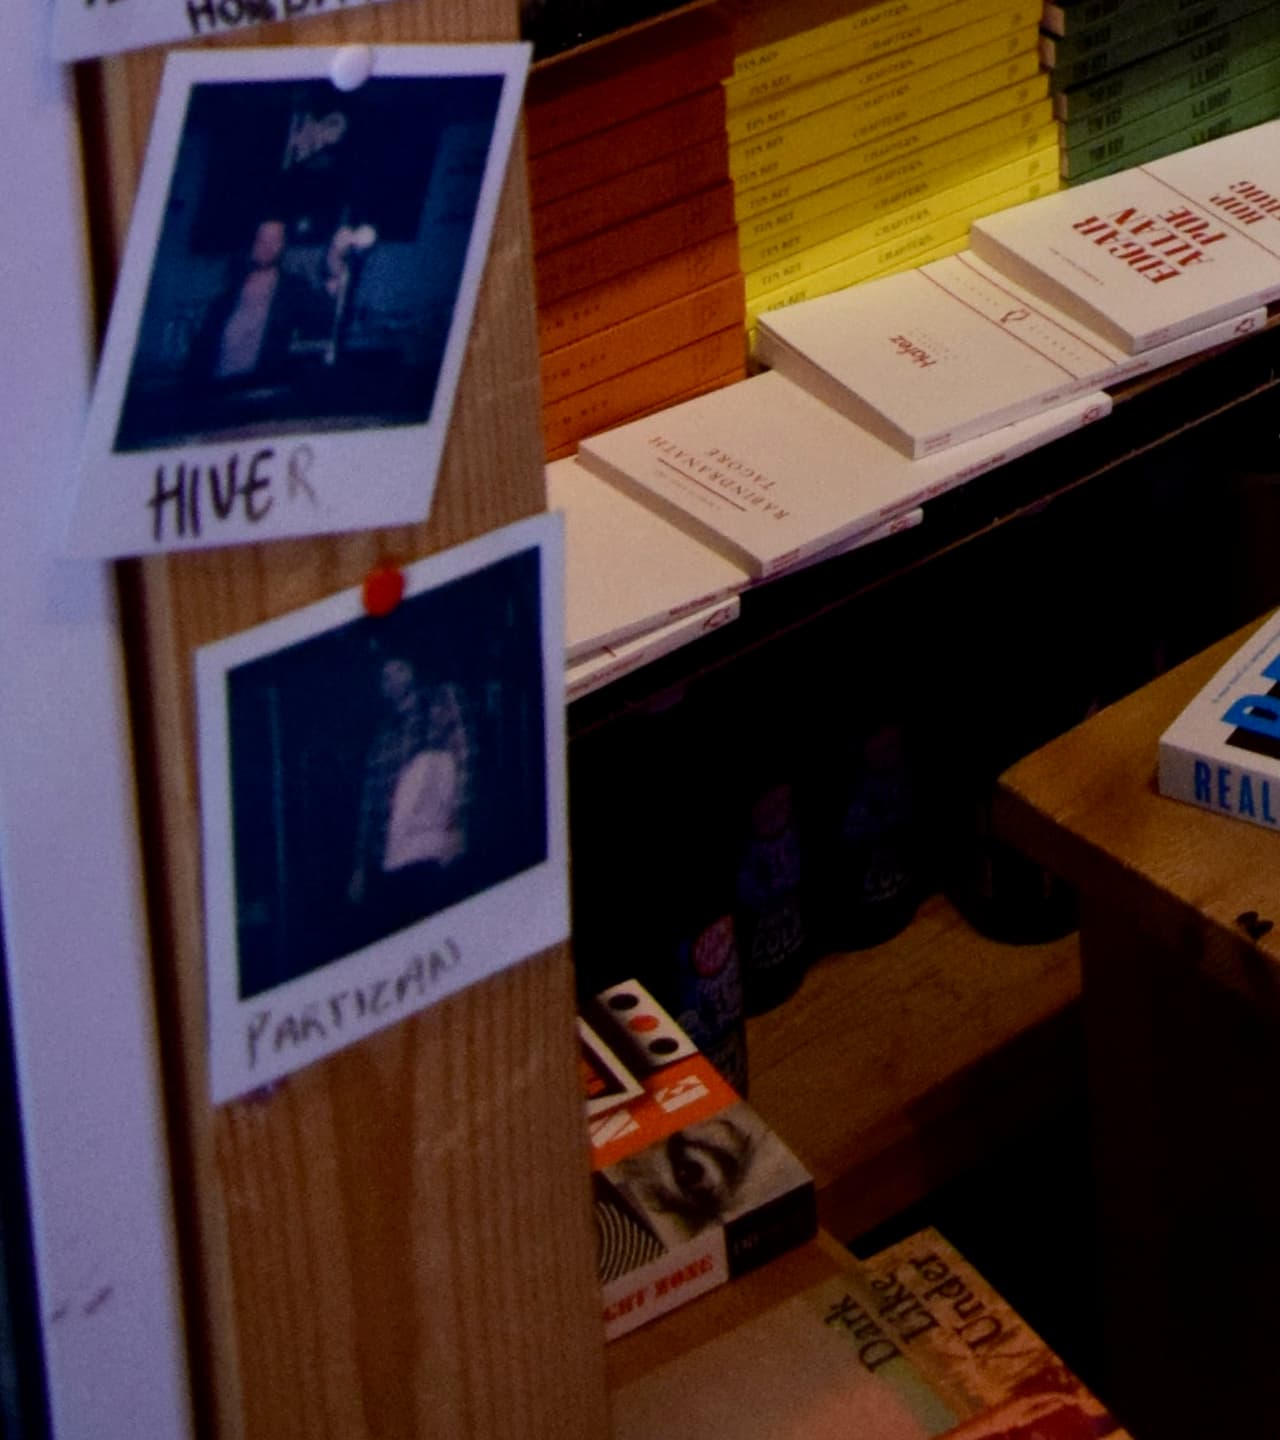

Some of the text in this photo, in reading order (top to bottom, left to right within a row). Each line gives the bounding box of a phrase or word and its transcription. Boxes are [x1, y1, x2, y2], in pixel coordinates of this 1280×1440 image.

[1071, 215, 1183, 285] EDGAR
[148, 443, 321, 543] HIVER
[242, 936, 465, 1072] PARTIZAN
